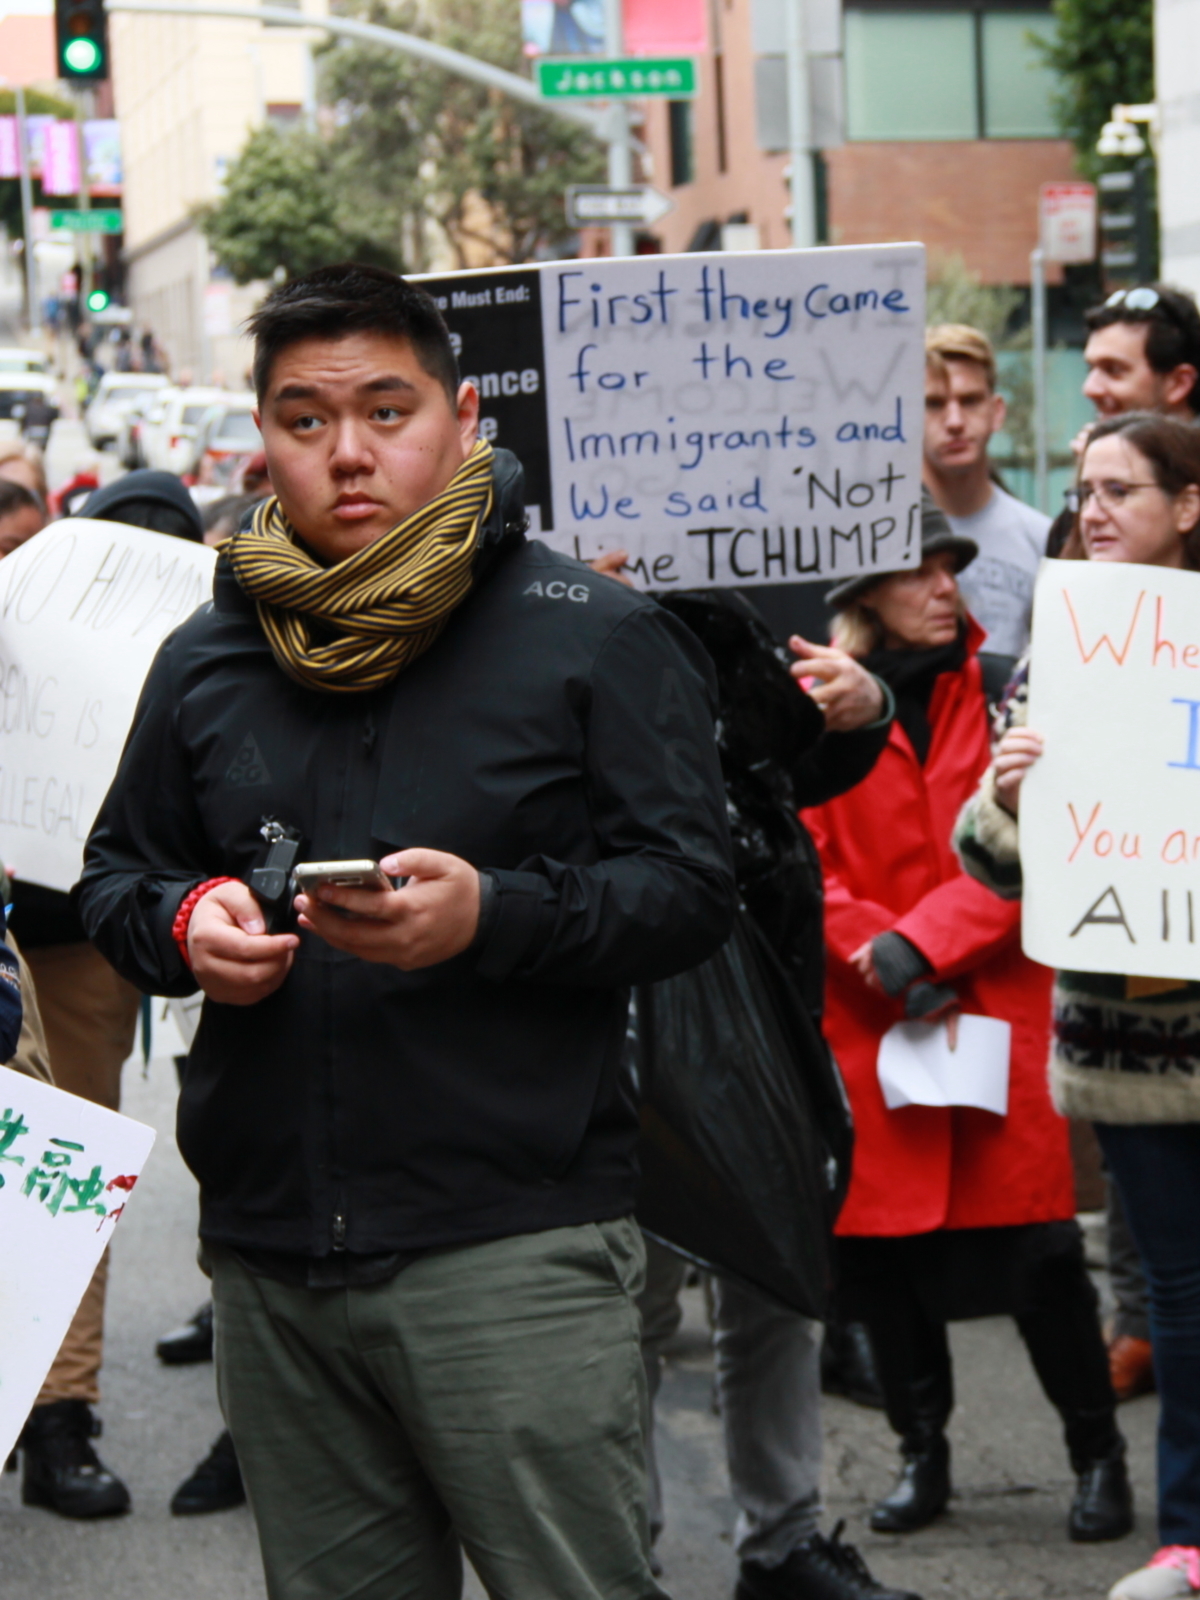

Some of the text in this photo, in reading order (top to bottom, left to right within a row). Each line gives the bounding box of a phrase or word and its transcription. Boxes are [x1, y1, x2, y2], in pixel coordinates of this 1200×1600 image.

[556, 67, 682, 92] Jackson
[451, 289, 491, 309] Must
[495, 285, 530, 304] End:
[558, 270, 677, 333] First
[696, 265, 792, 338] they
[569, 342, 795, 394] for the
[564, 396, 907, 470] Immigrants and
[570, 482, 641, 521] We
[522, 580, 590, 603] ACG
[74, 697, 103, 749] IS
[1067, 801, 1143, 864] You
[1068, 885, 1195, 945] All
